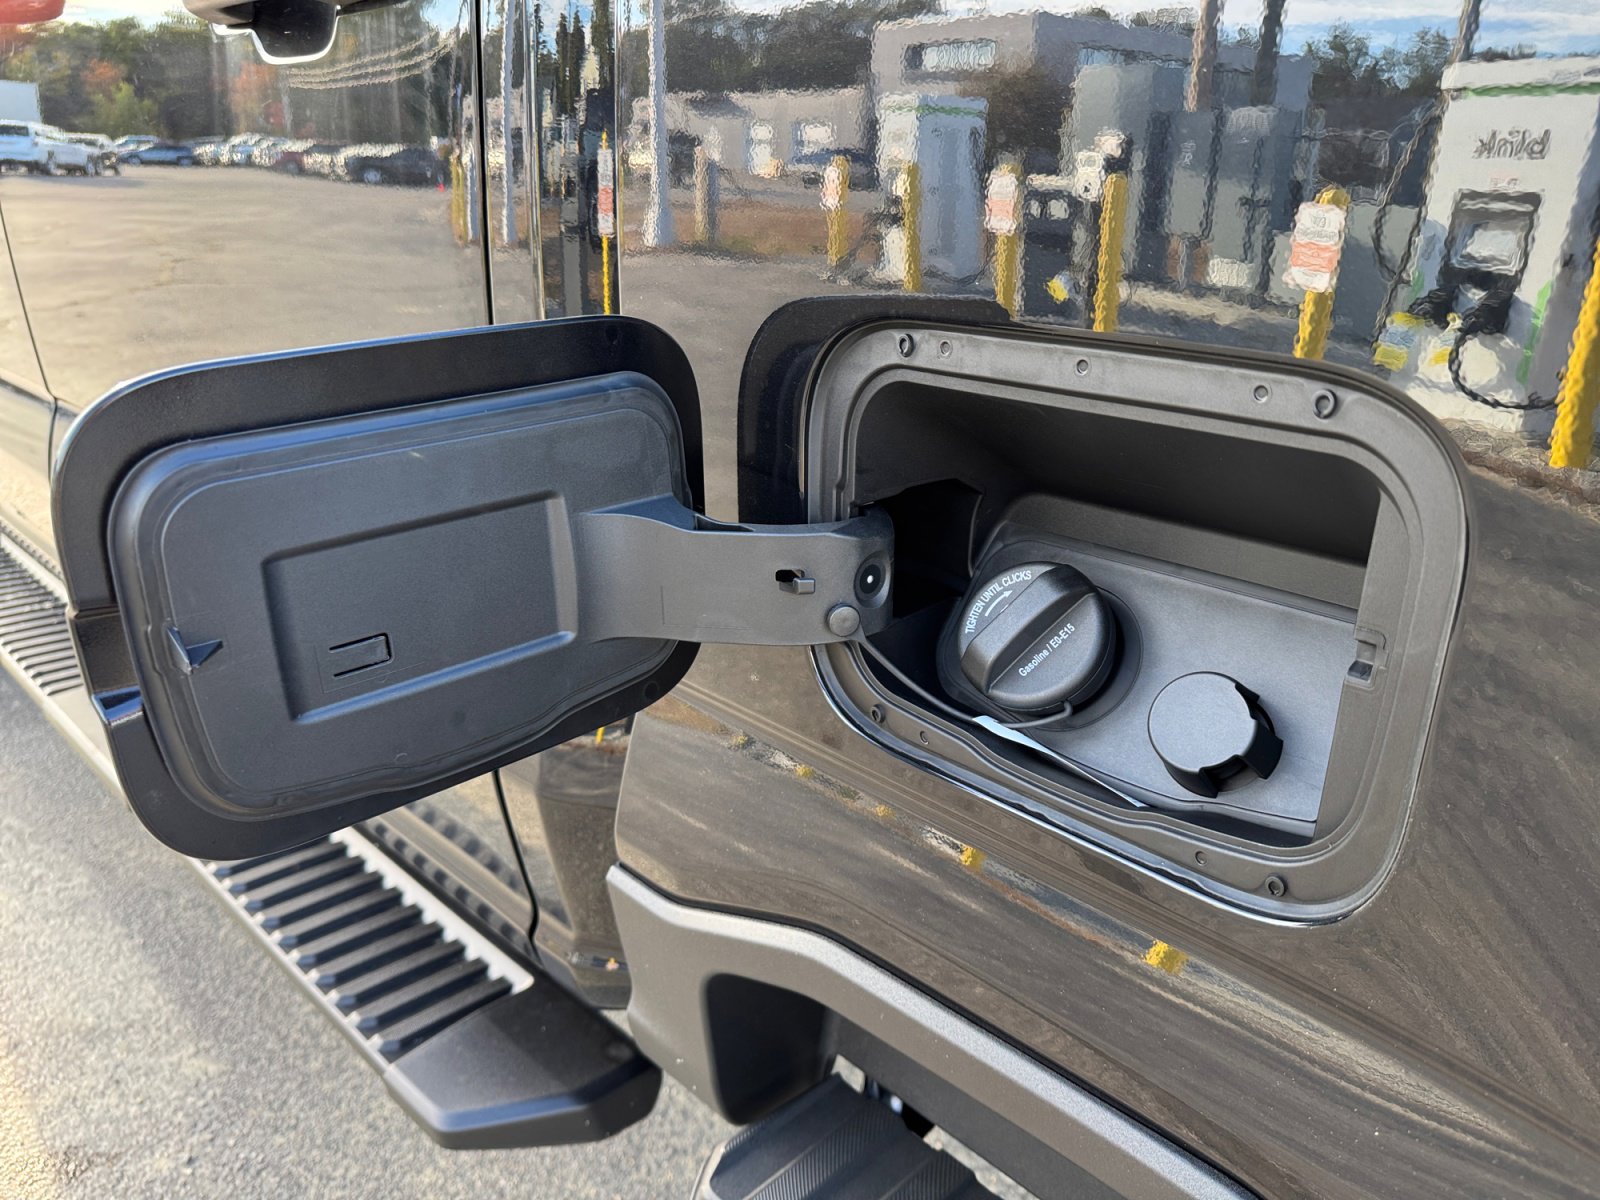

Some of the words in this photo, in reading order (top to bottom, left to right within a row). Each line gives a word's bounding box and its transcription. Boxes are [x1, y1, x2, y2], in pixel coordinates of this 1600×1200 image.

[965, 600, 986, 634] TIGHTEN
[980, 583, 1003, 606] UNTIL
[1002, 570, 1032, 587] CLICKS
[1018, 648, 1049, 677] Gasoline
[1050, 623, 1075, 649] E0-E15
